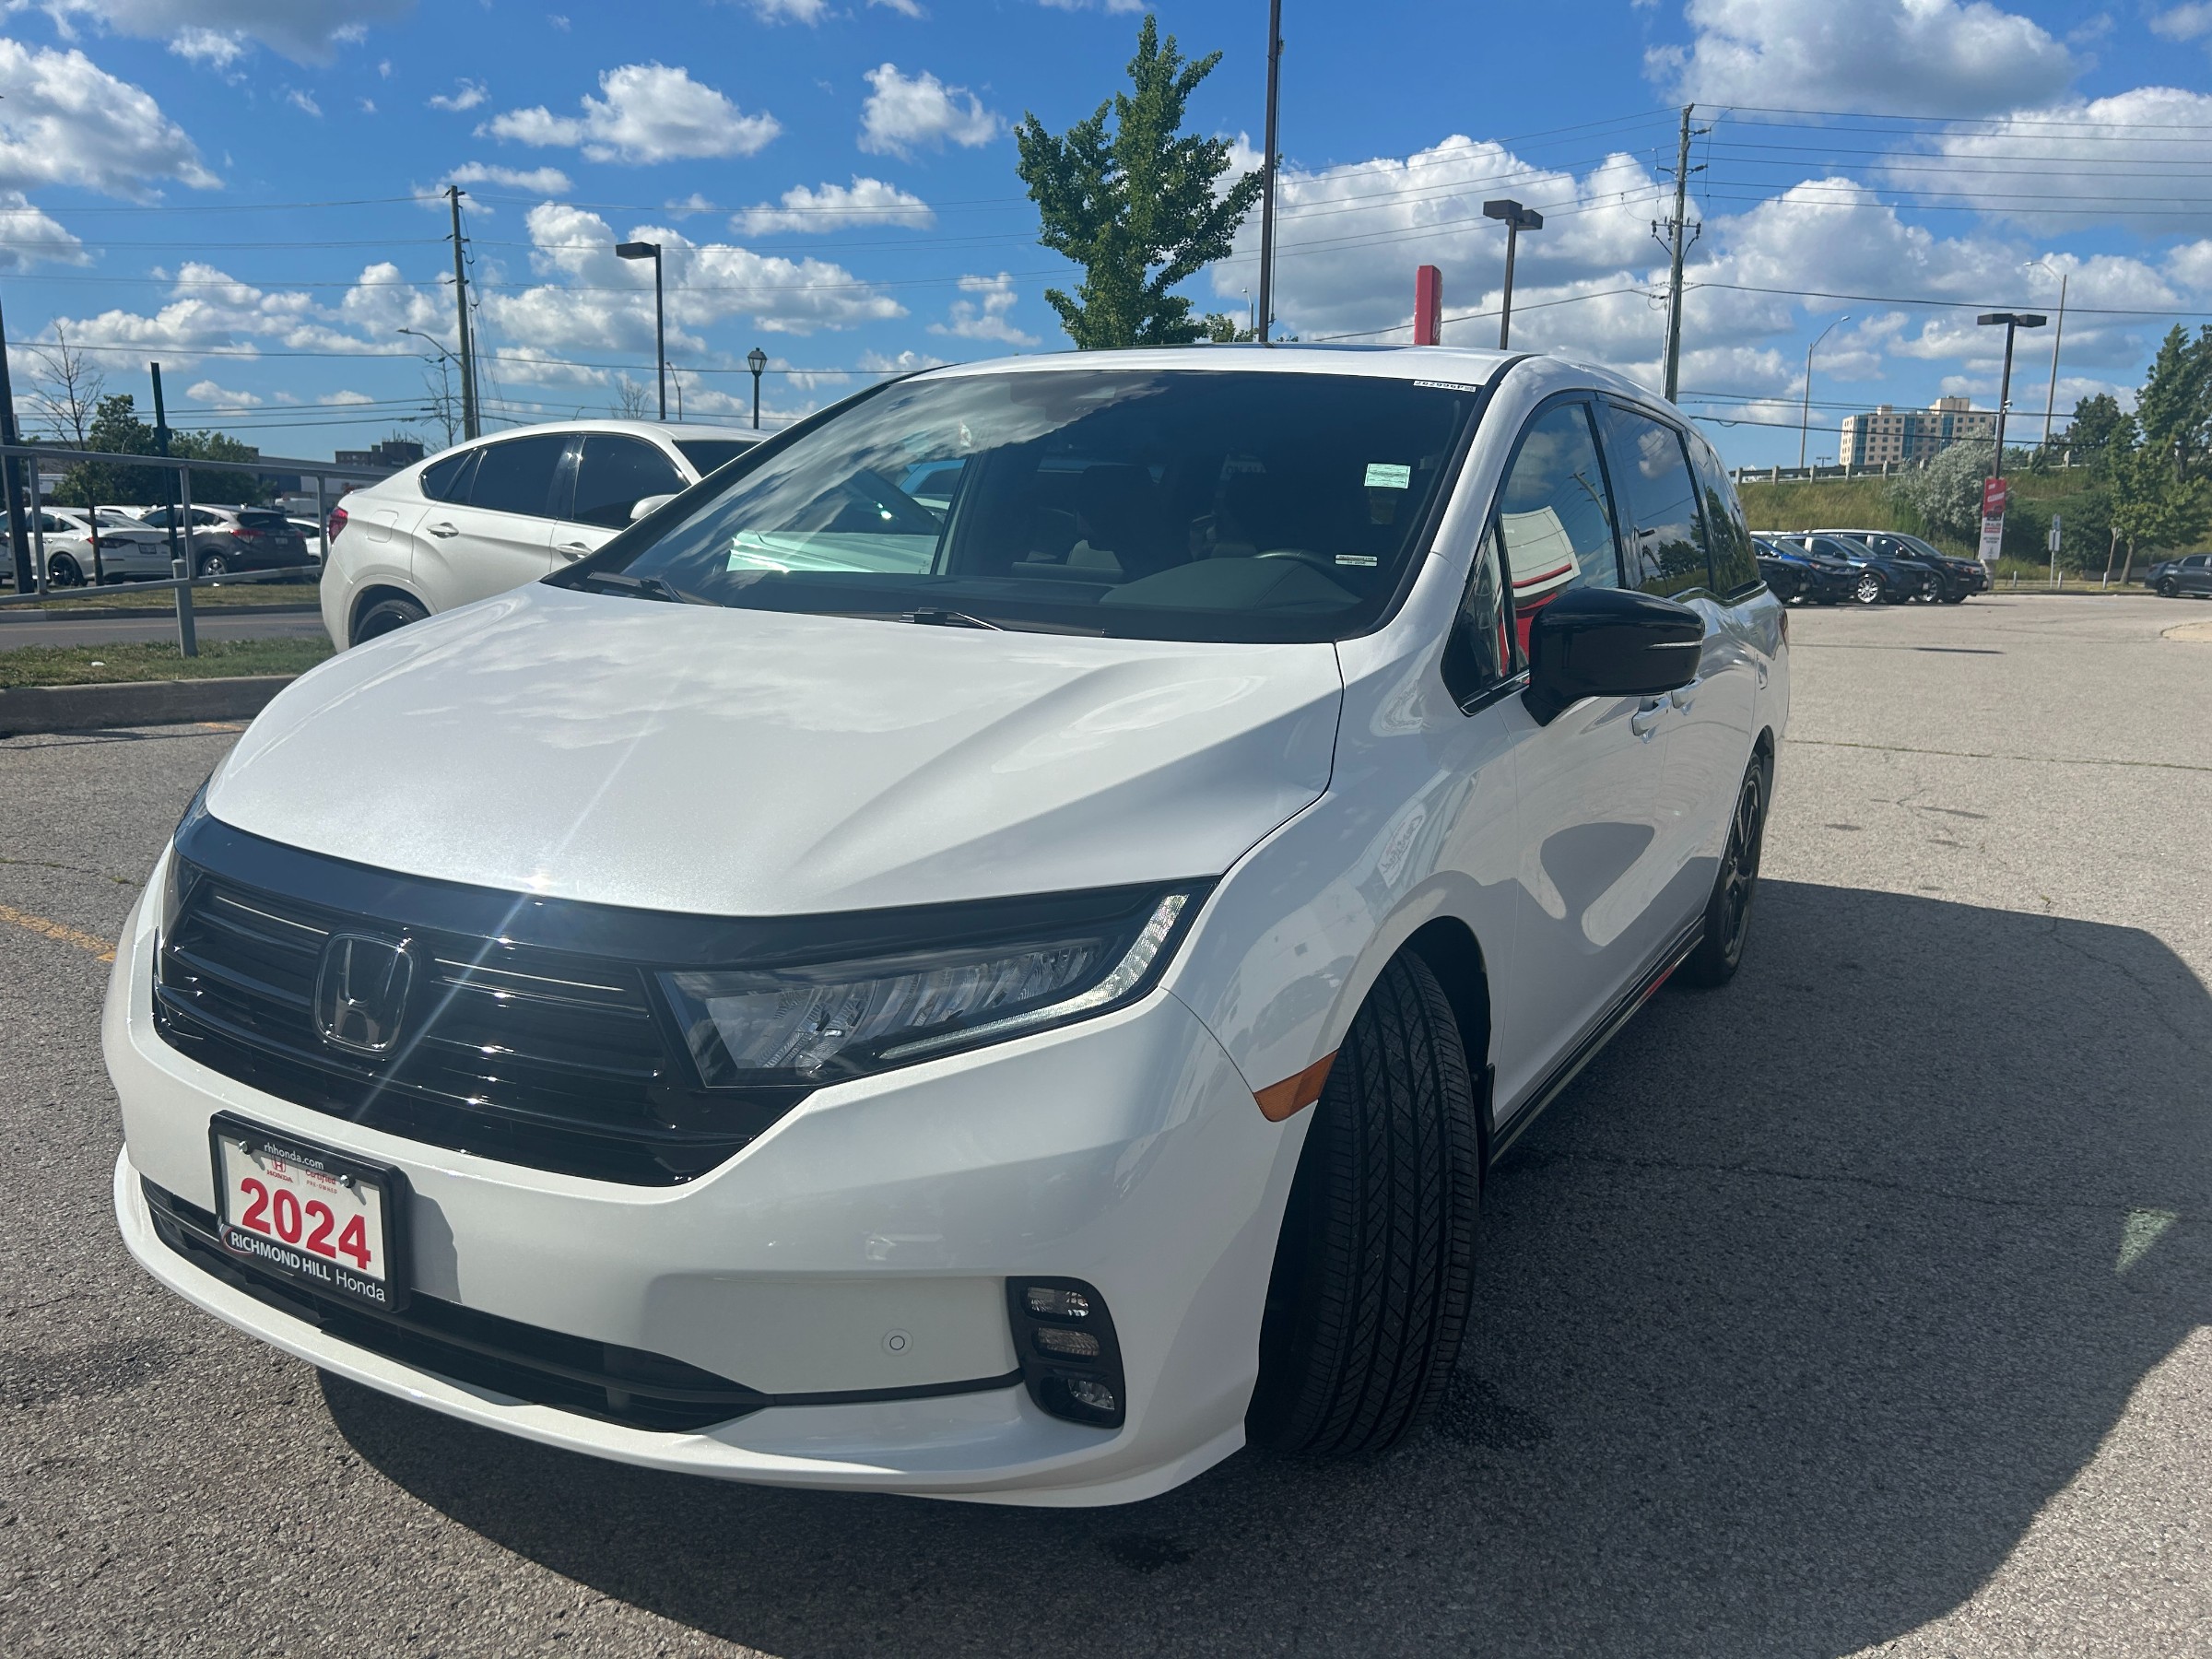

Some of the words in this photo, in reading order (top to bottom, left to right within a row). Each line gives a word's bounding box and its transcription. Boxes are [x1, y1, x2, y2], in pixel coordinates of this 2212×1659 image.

[264, 1142, 324, 1171] rhhonda.com
[266, 1170, 294, 1183] HONDA
[305, 1169, 336, 1185] Certified
[241, 1177, 371, 1271] 2024
[231, 1232, 300, 1269] RICHMOND
[302, 1259, 331, 1281] HILL
[335, 1268, 386, 1302] Honda
